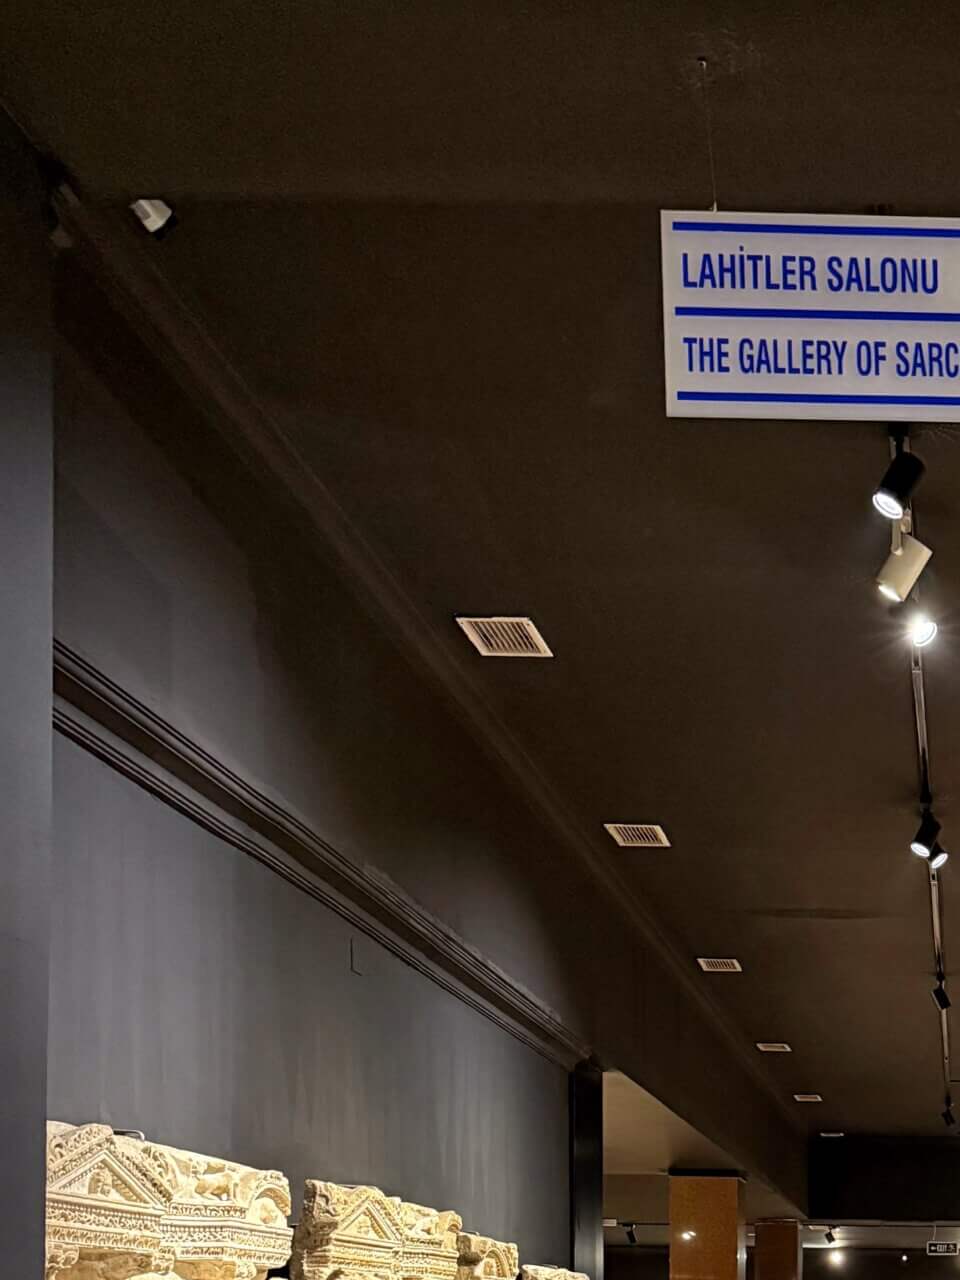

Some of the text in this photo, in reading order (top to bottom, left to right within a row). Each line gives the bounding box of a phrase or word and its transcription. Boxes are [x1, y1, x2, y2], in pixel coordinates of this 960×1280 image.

[682, 246, 939, 294] LAHİTLER SALONU
[683, 337, 730, 373] THE
[738, 338, 847, 376] GALLERY
[856, 341, 887, 376] OF
